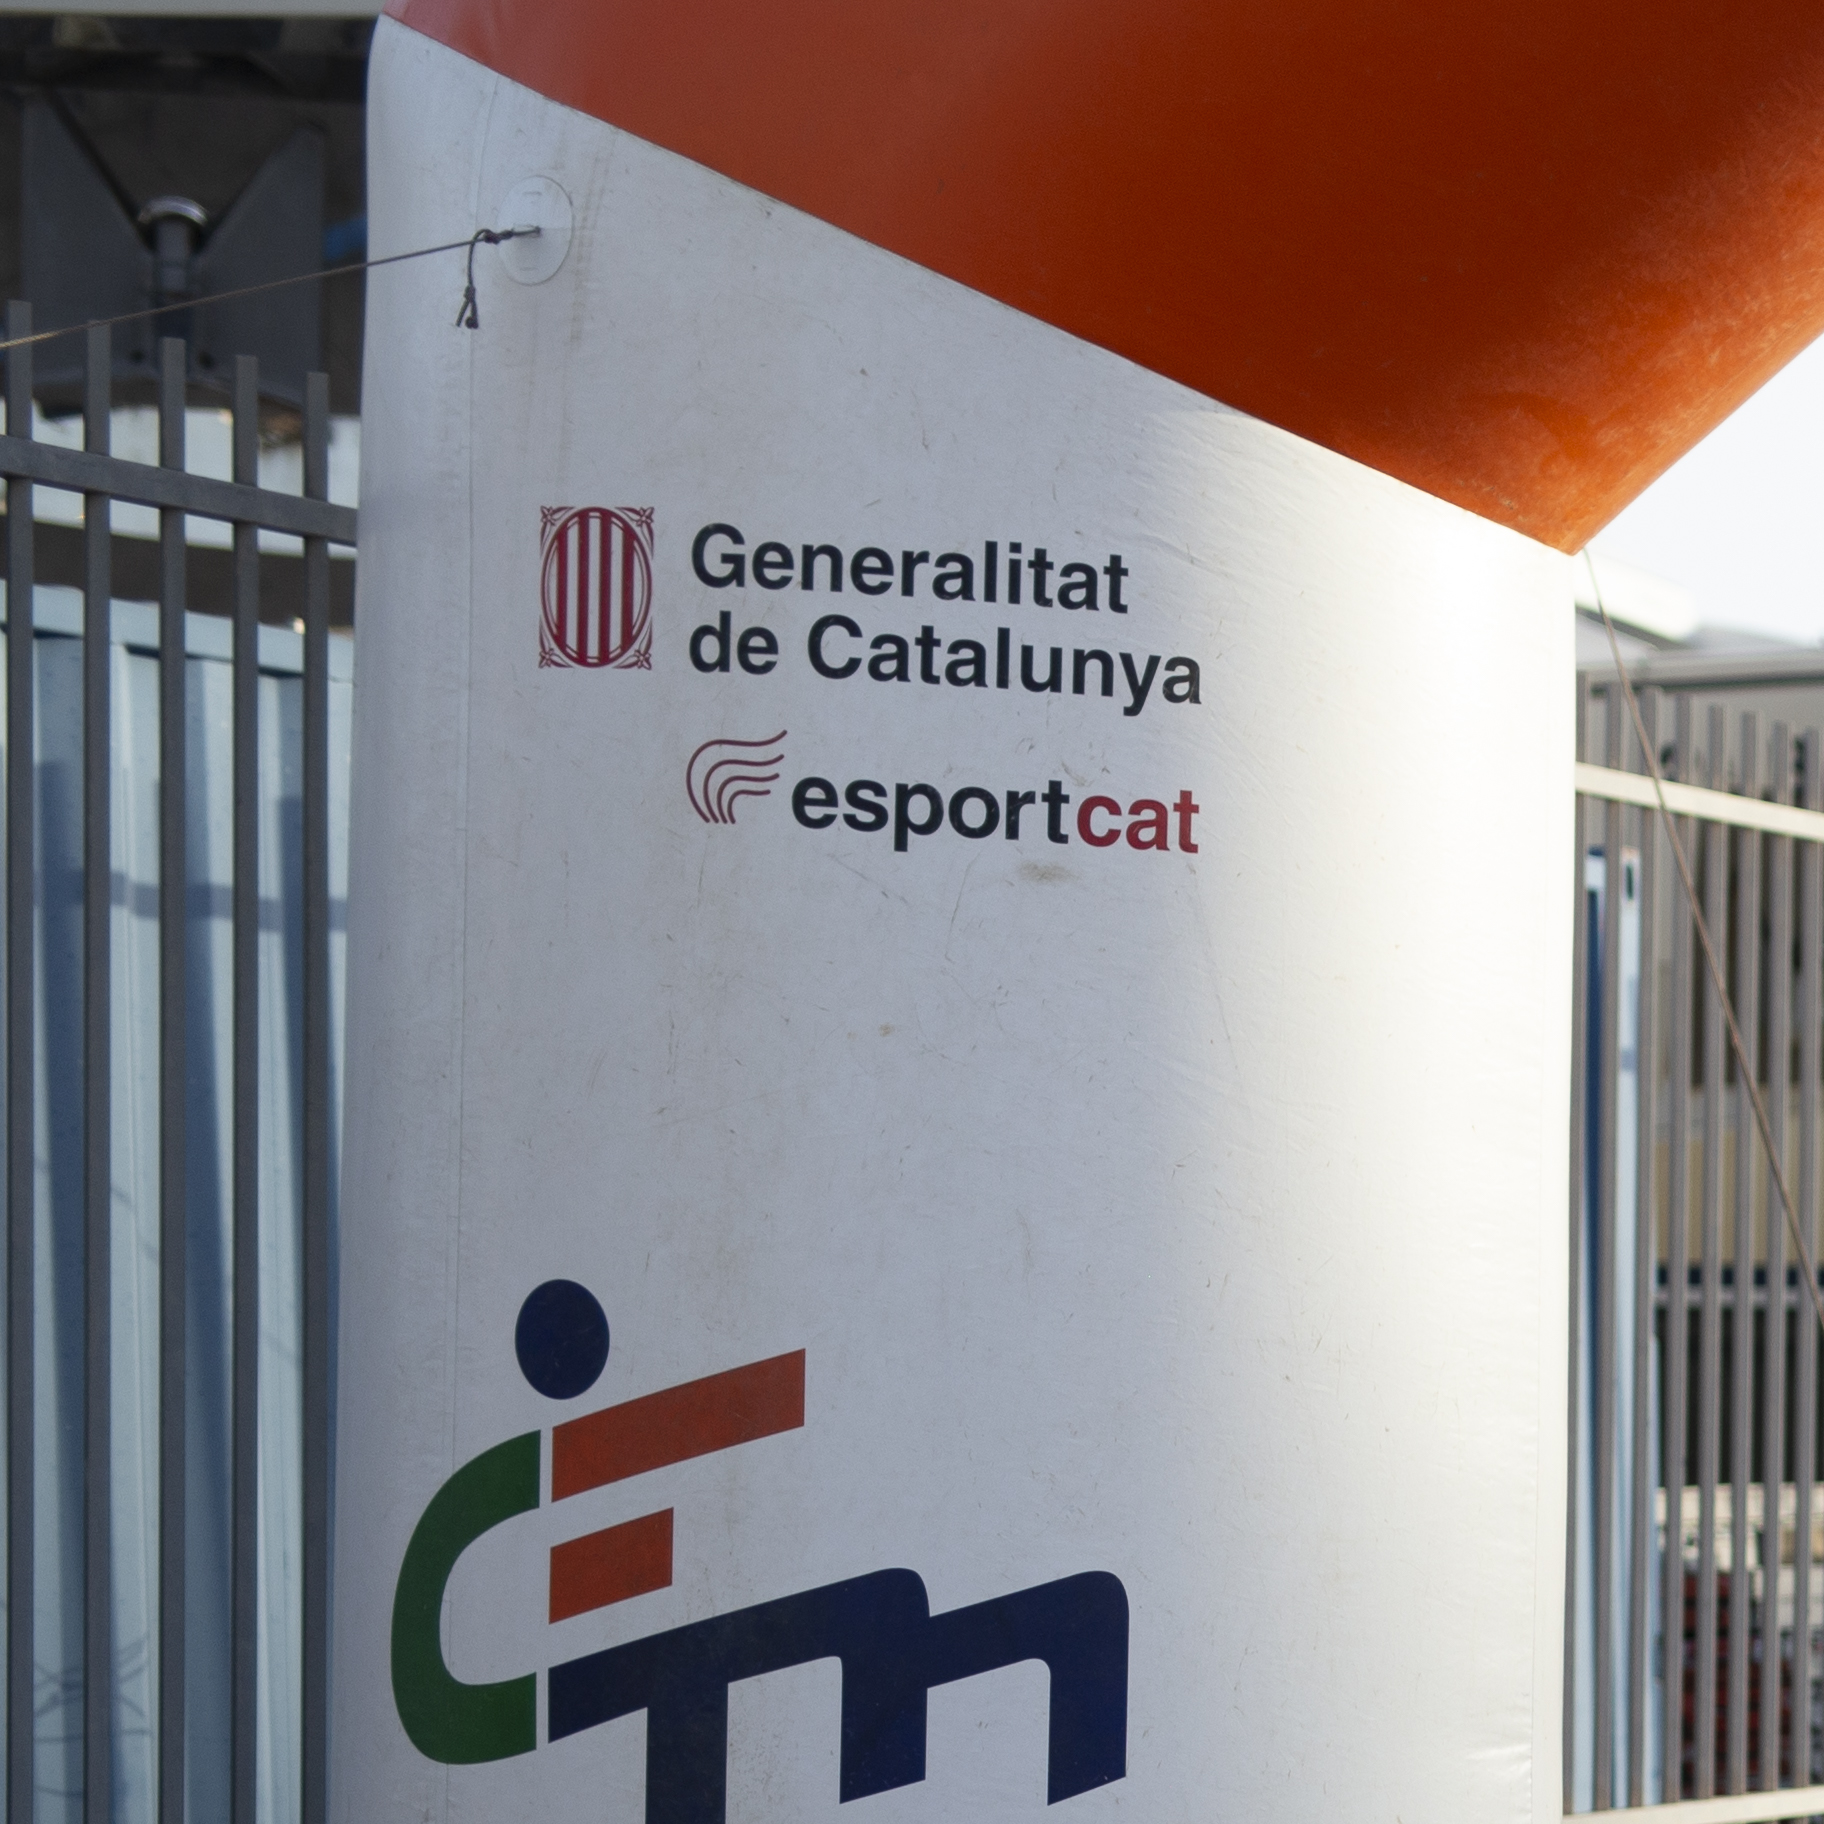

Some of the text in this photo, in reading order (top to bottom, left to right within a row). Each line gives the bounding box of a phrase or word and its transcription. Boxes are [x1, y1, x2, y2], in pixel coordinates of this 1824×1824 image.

[691, 522, 1129, 615] Generalitat
[688, 609, 1202, 717] de Catalunya
[791, 776, 1200, 855] esportcat
